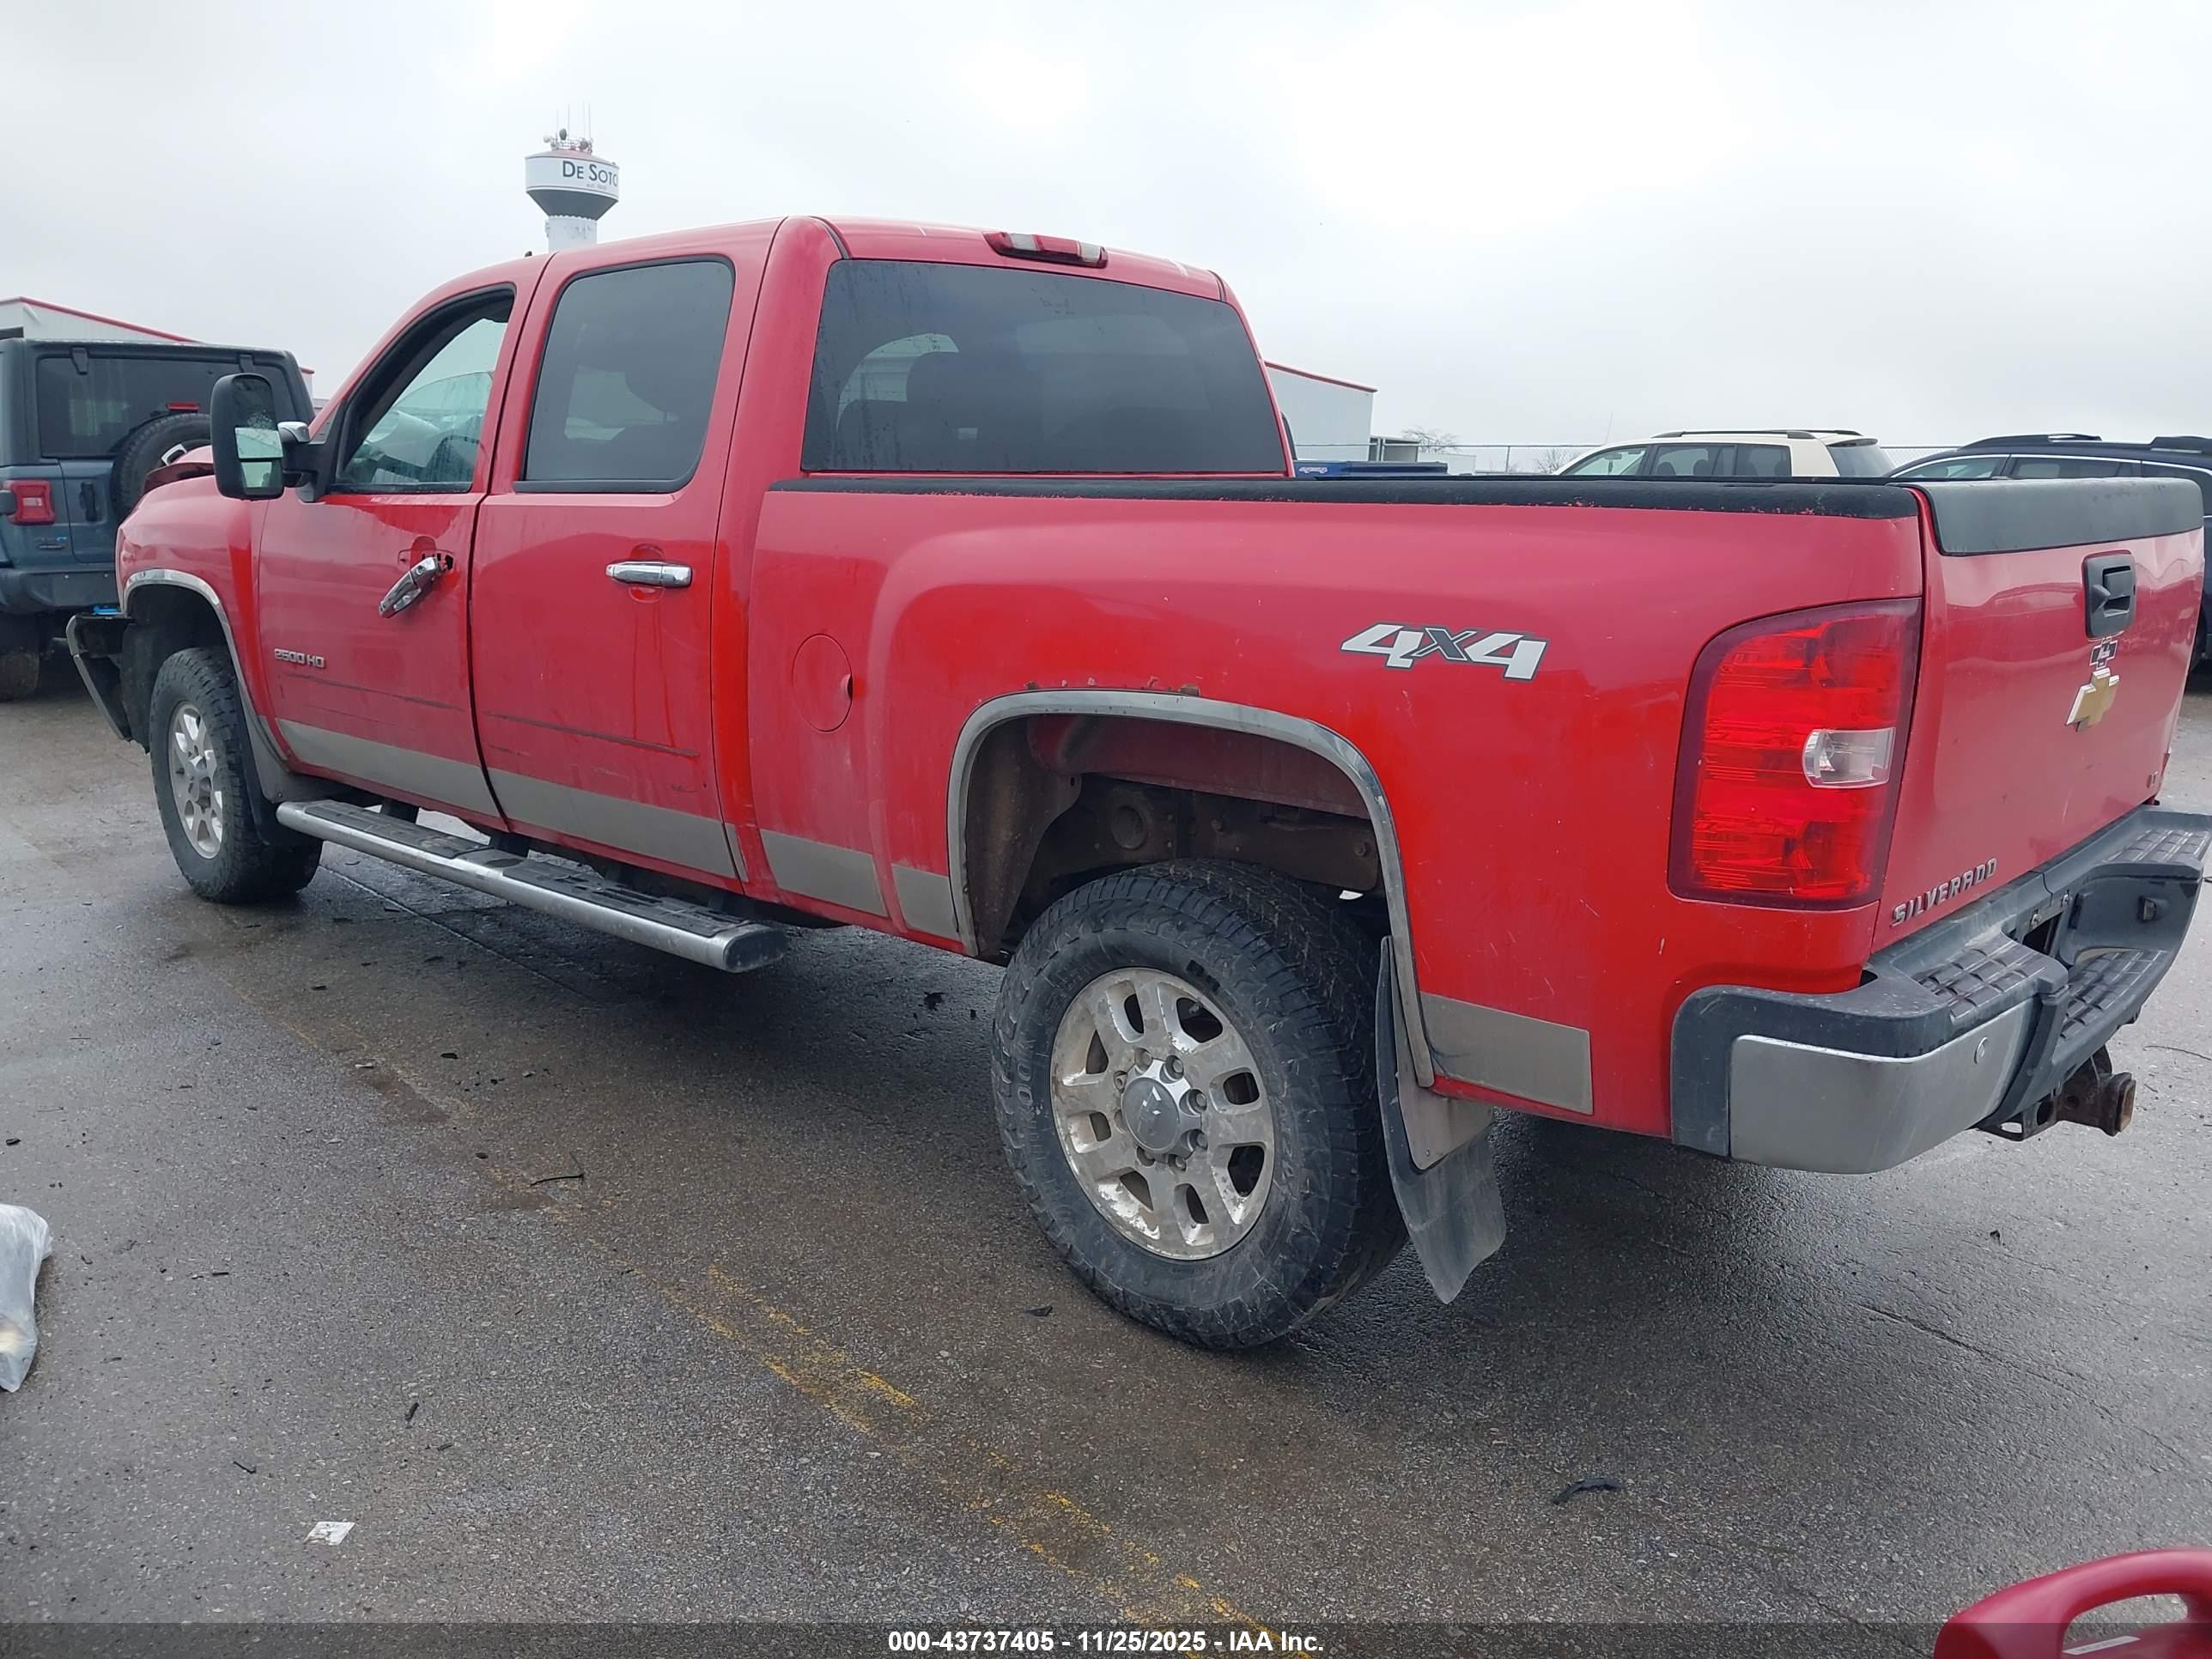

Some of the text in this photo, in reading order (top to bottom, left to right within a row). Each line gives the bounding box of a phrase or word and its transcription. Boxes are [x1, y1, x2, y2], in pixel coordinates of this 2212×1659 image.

[274, 648, 325, 668] 2500 HD
[1891, 858, 1997, 927] SILVERADO
